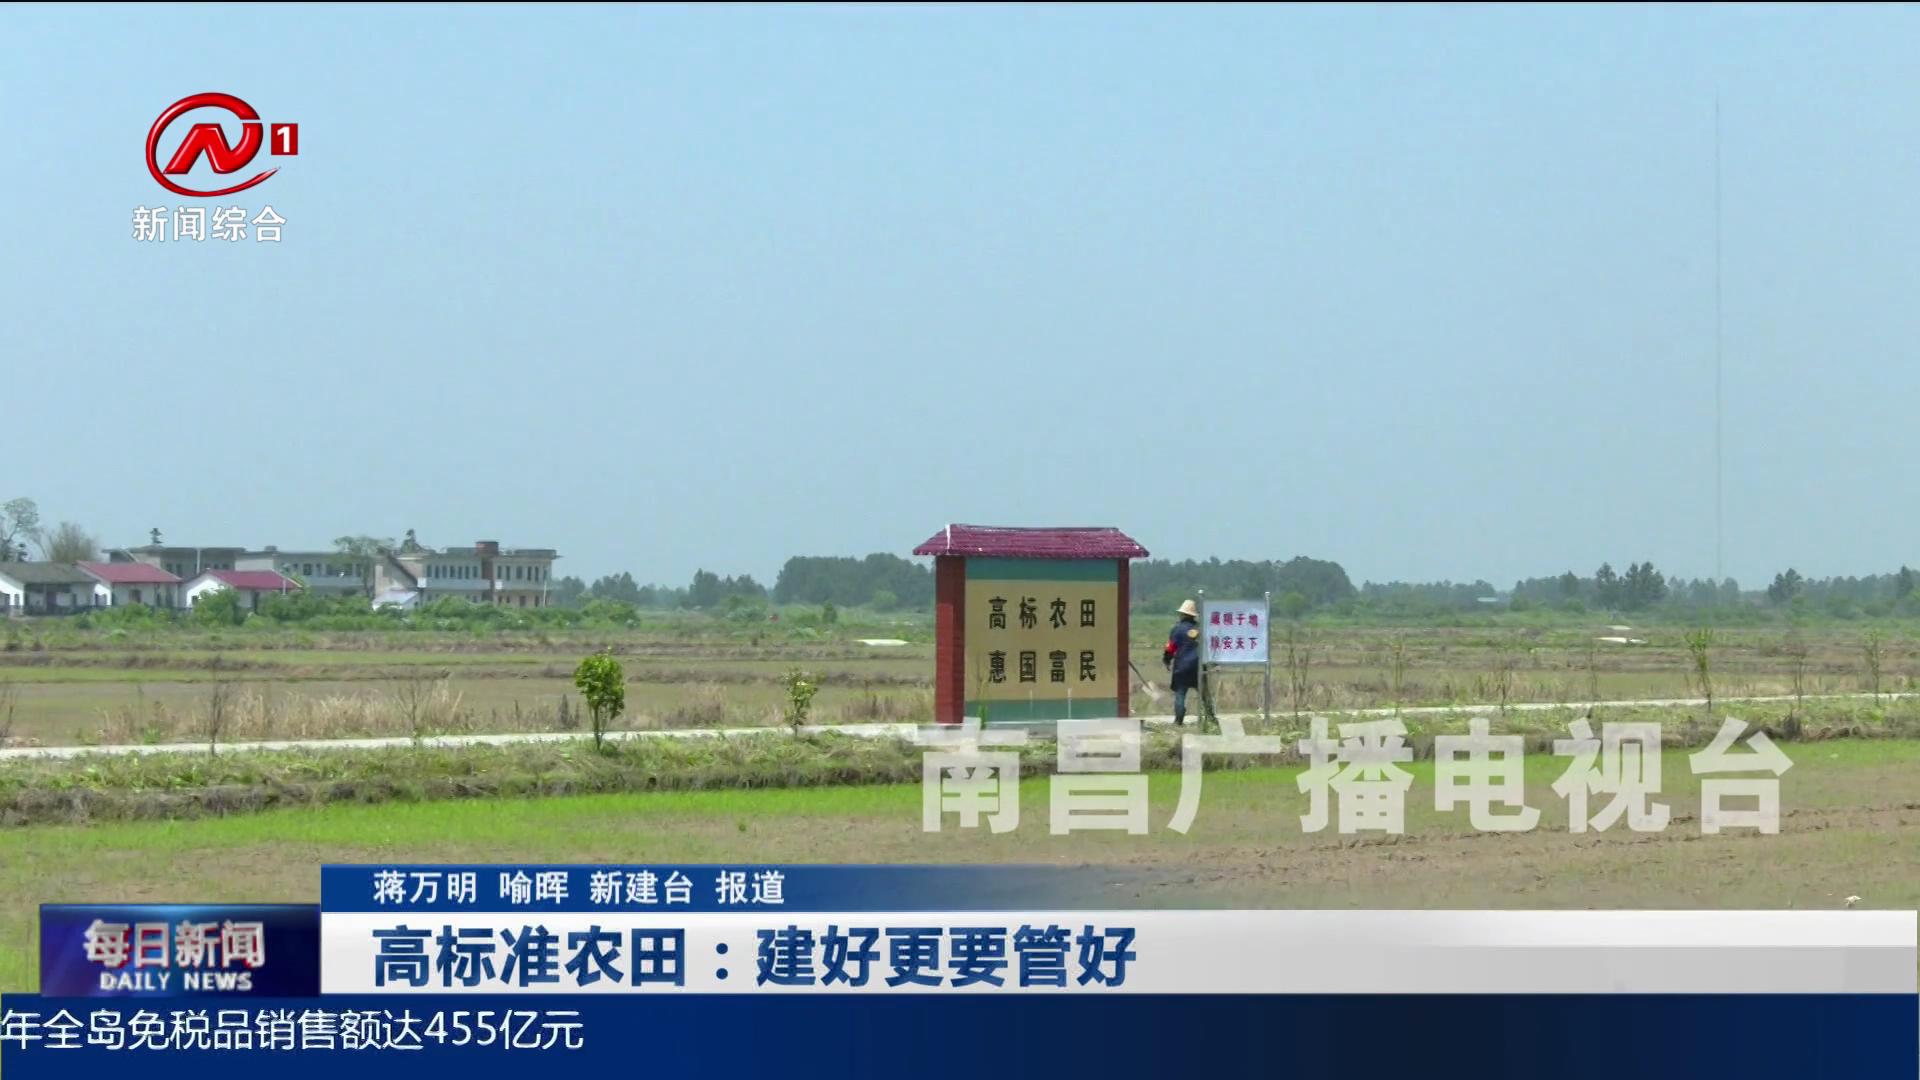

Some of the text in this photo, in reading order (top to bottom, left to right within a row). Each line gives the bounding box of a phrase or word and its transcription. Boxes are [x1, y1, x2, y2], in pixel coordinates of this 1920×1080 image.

[988, 596, 1096, 630] 高标农田
[988, 649, 1097, 684] 惠国富民
